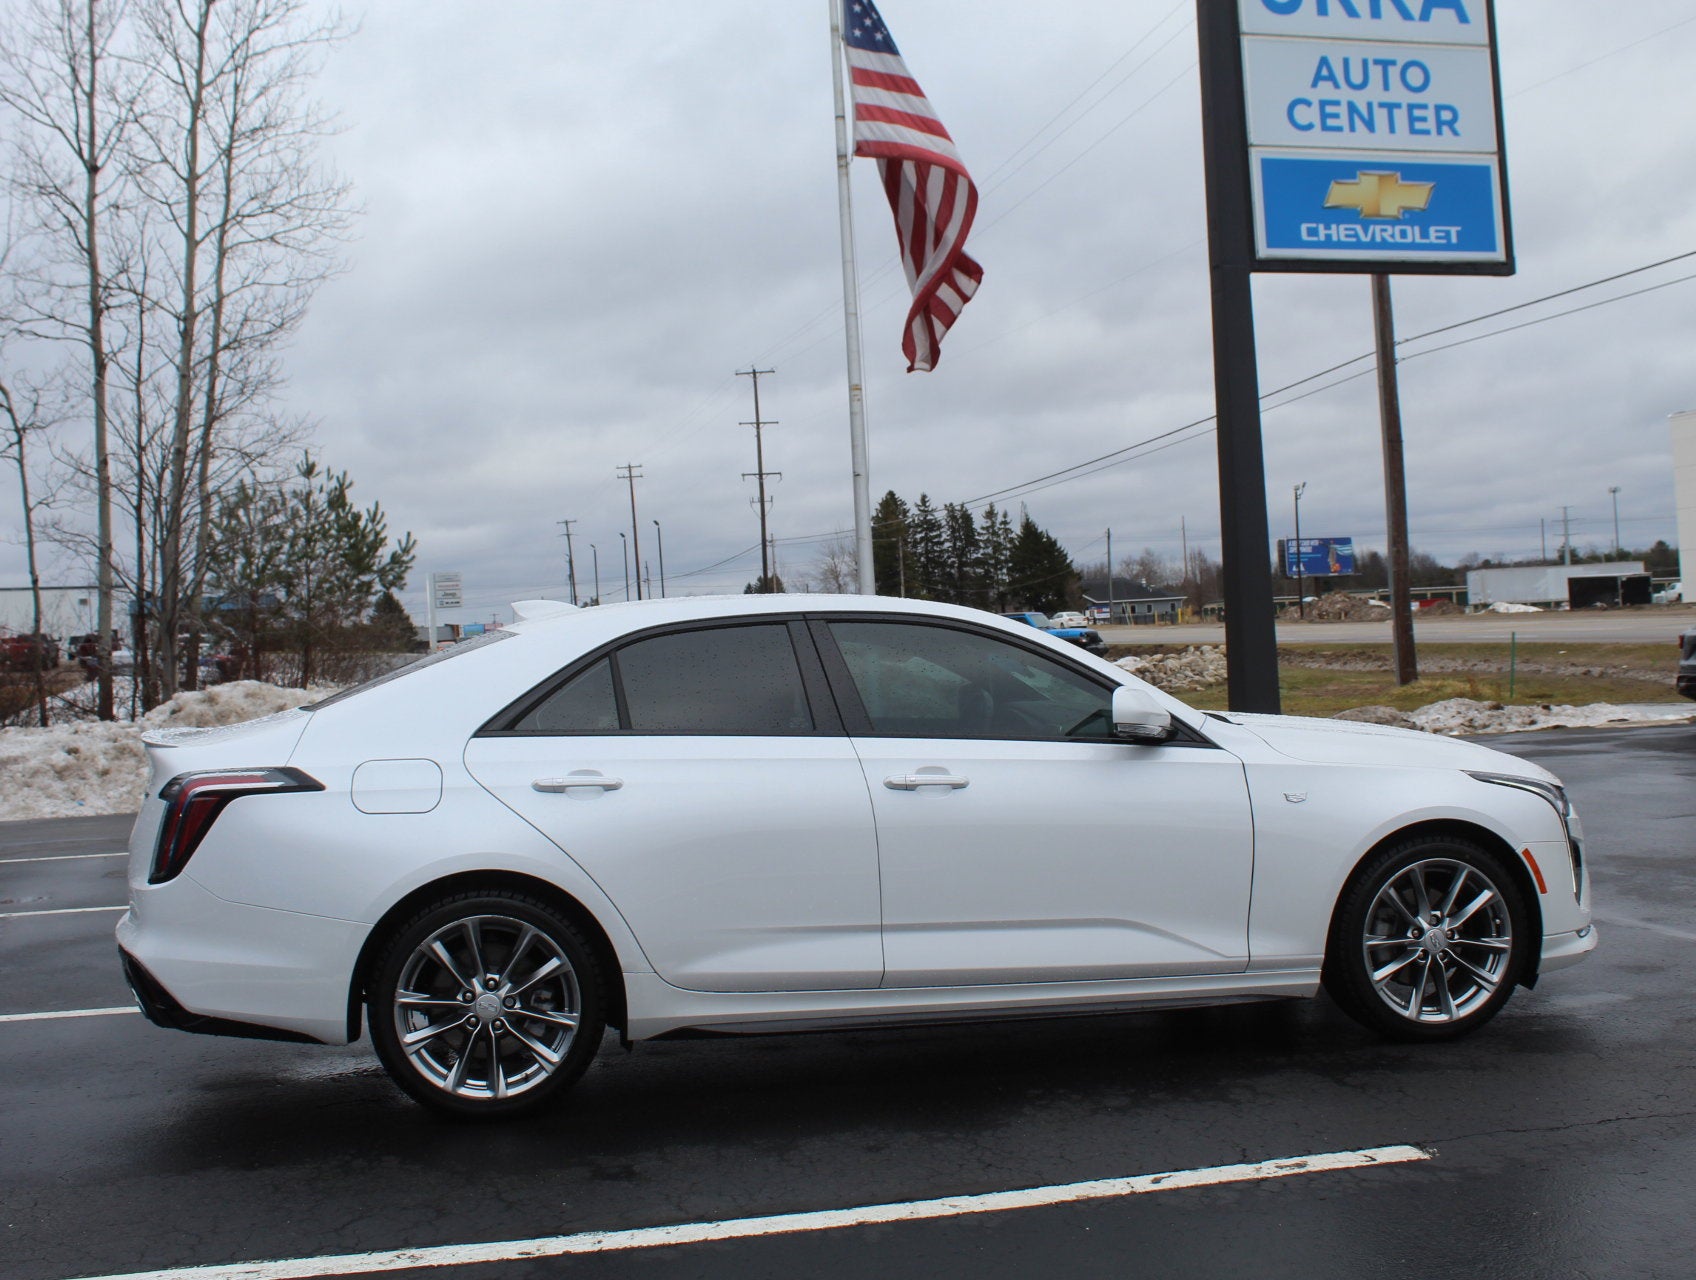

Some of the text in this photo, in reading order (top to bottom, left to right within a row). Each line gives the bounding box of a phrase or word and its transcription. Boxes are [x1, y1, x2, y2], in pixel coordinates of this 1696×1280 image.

[1311, 55, 1432, 93] AUTO
[1286, 97, 1462, 137] CENTER
[1300, 222, 1462, 244] CHEVROLET
